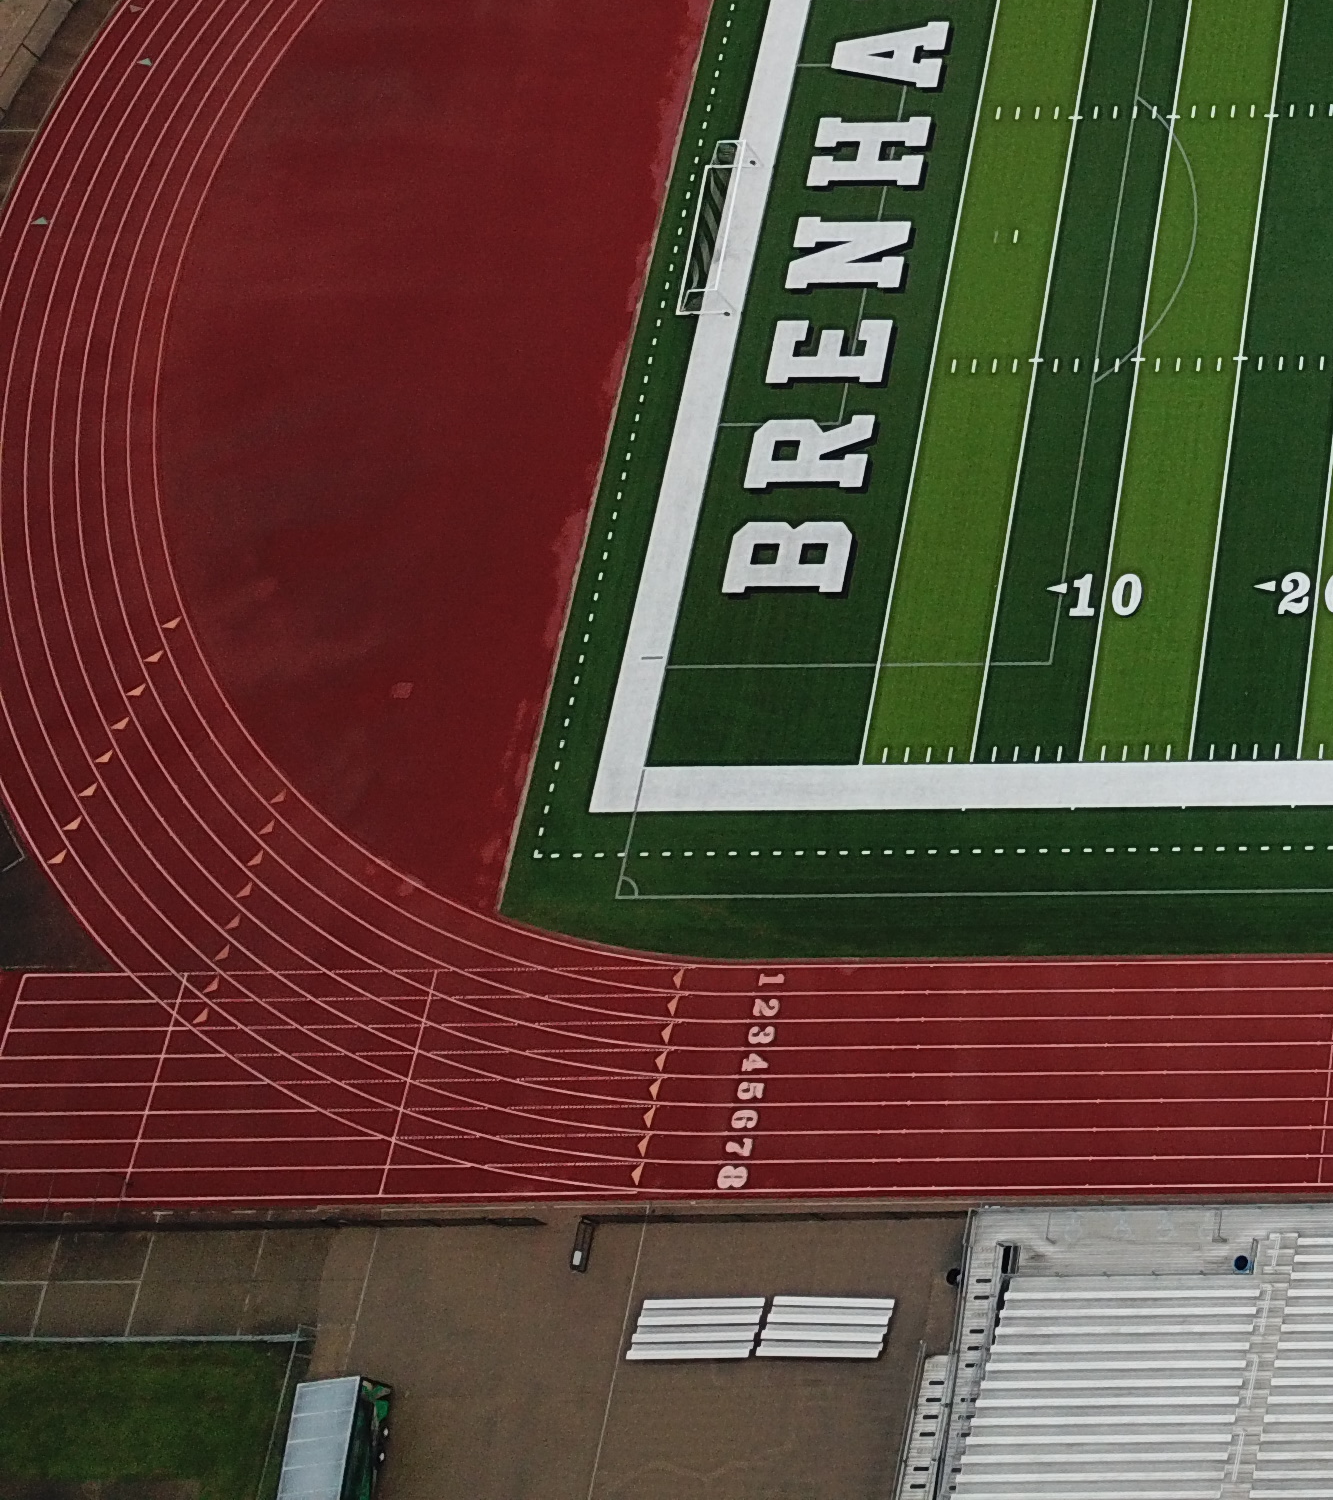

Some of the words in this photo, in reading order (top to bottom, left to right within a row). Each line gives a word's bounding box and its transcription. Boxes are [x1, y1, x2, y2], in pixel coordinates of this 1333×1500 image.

[1067, 574, 1143, 617] 10
[759, 974, 784, 986] 1
[753, 999, 780, 1016] 2
[748, 1026, 775, 1044] 3
[742, 1053, 768, 1071] 4
[737, 1082, 764, 1100] 5
[731, 1110, 758, 1128] 6
[726, 1138, 752, 1156] 7
[717, 1166, 748, 1189] 8
